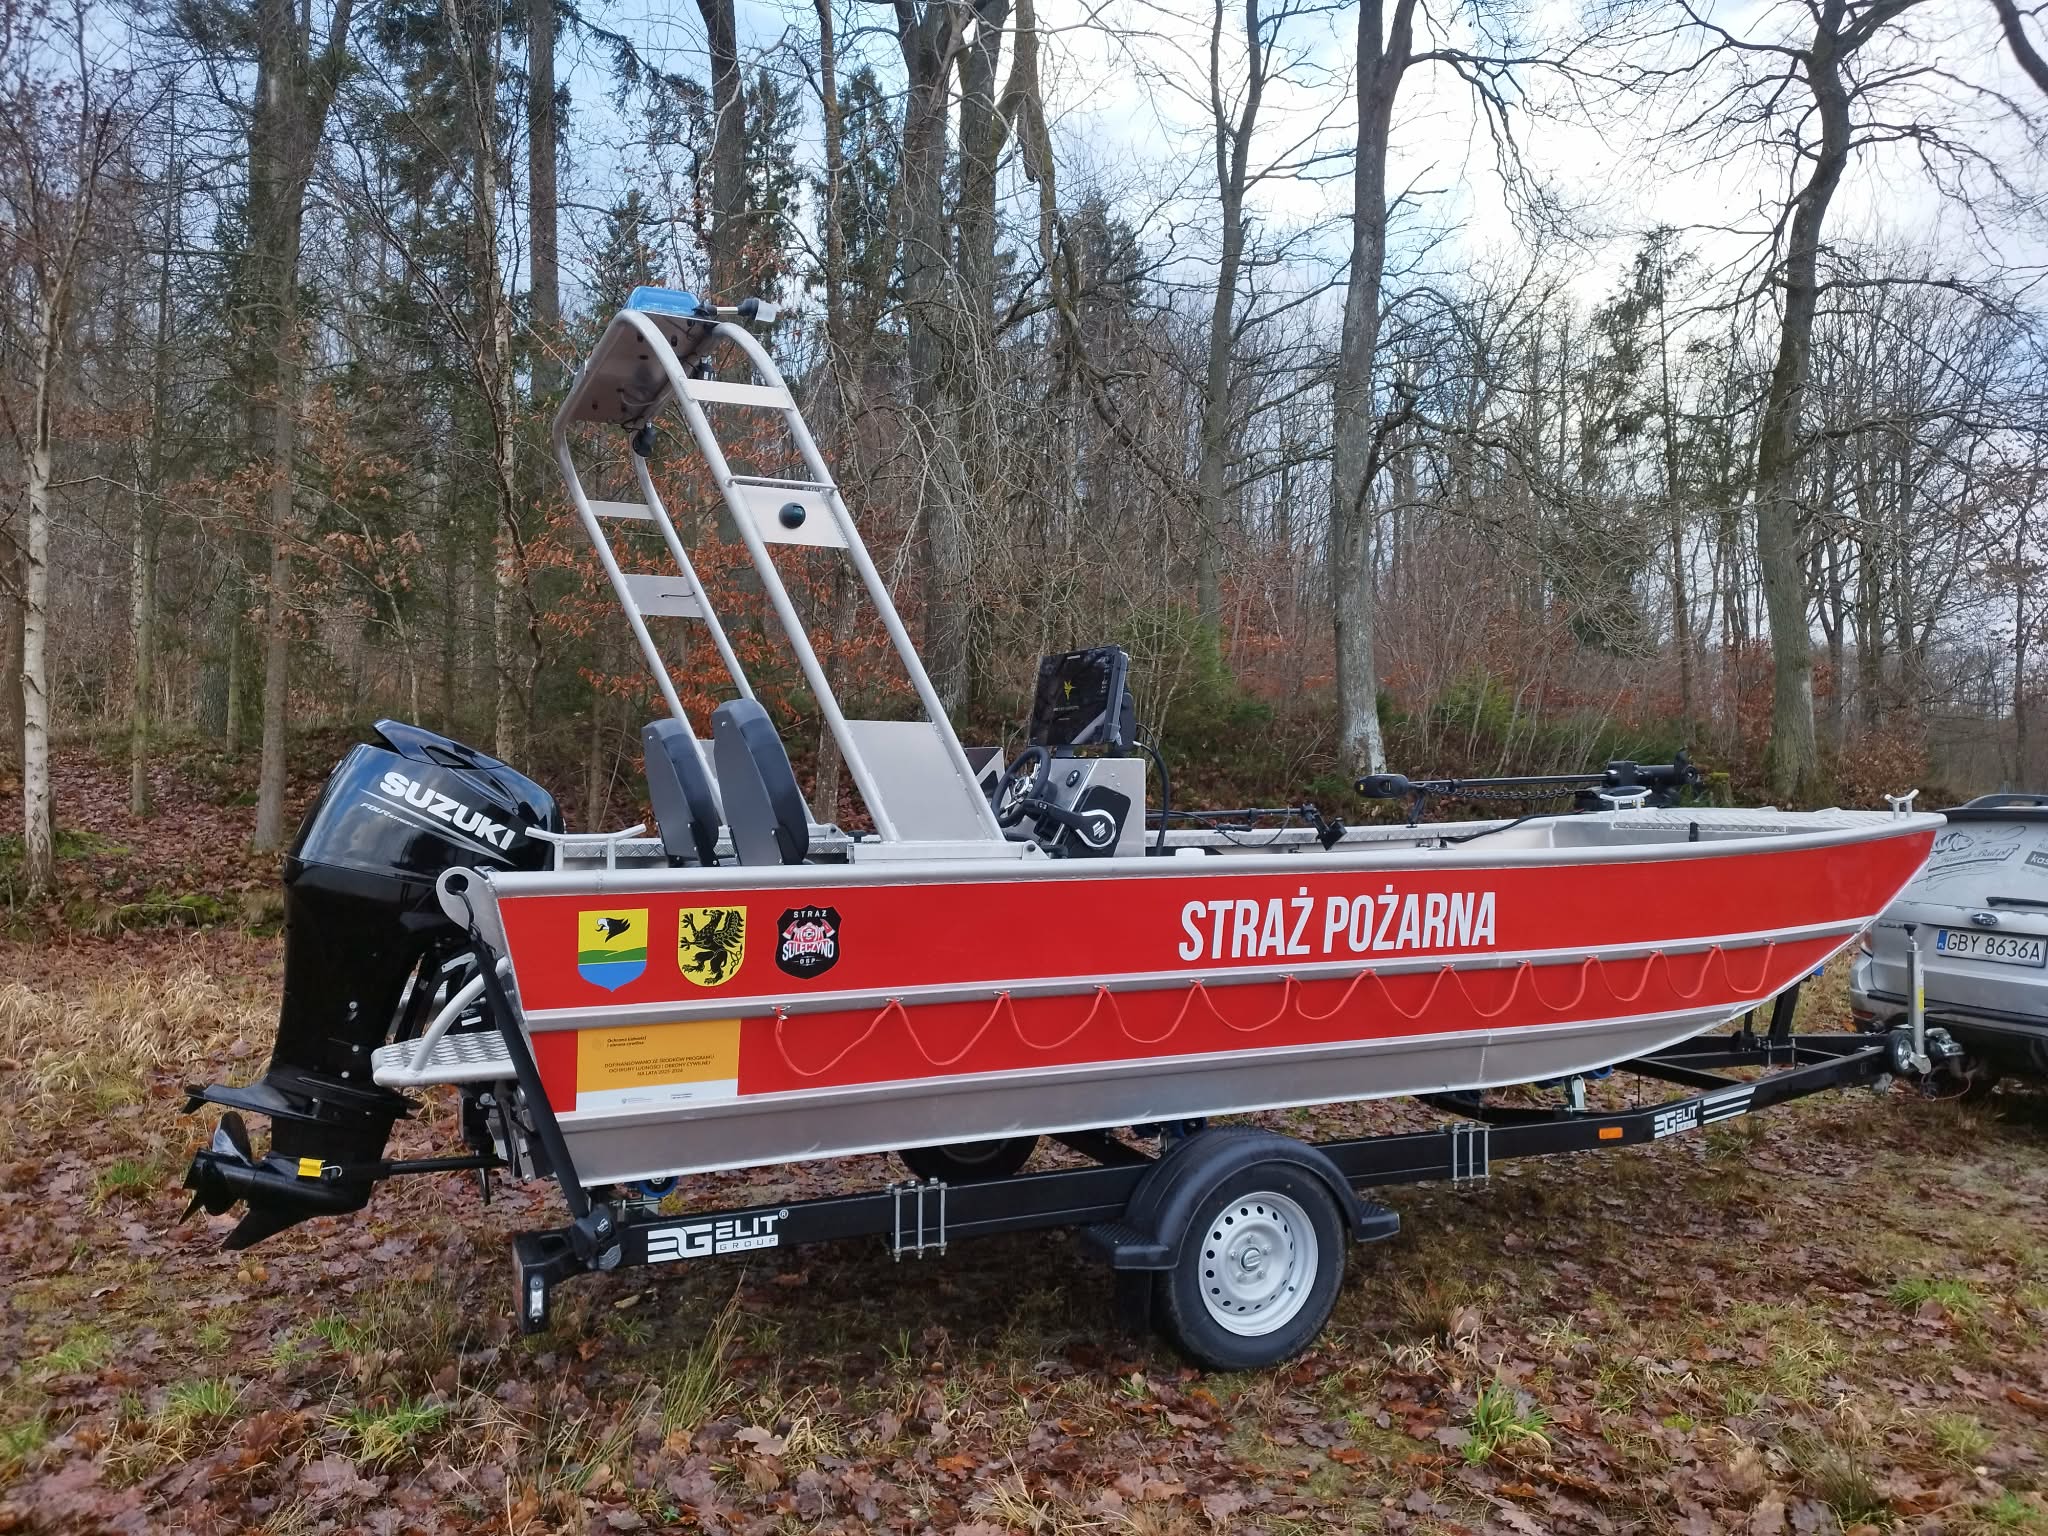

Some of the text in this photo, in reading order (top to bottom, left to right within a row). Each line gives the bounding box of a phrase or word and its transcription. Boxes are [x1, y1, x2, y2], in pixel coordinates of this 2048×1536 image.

[379, 771, 516, 851] SUZUKI
[1178, 884, 1496, 961] STRAŻ POŻARNA
[1947, 933, 1980, 953] GBY
[1985, 937, 2040, 961] 8636A
[719, 1237, 776, 1251] GROUP
